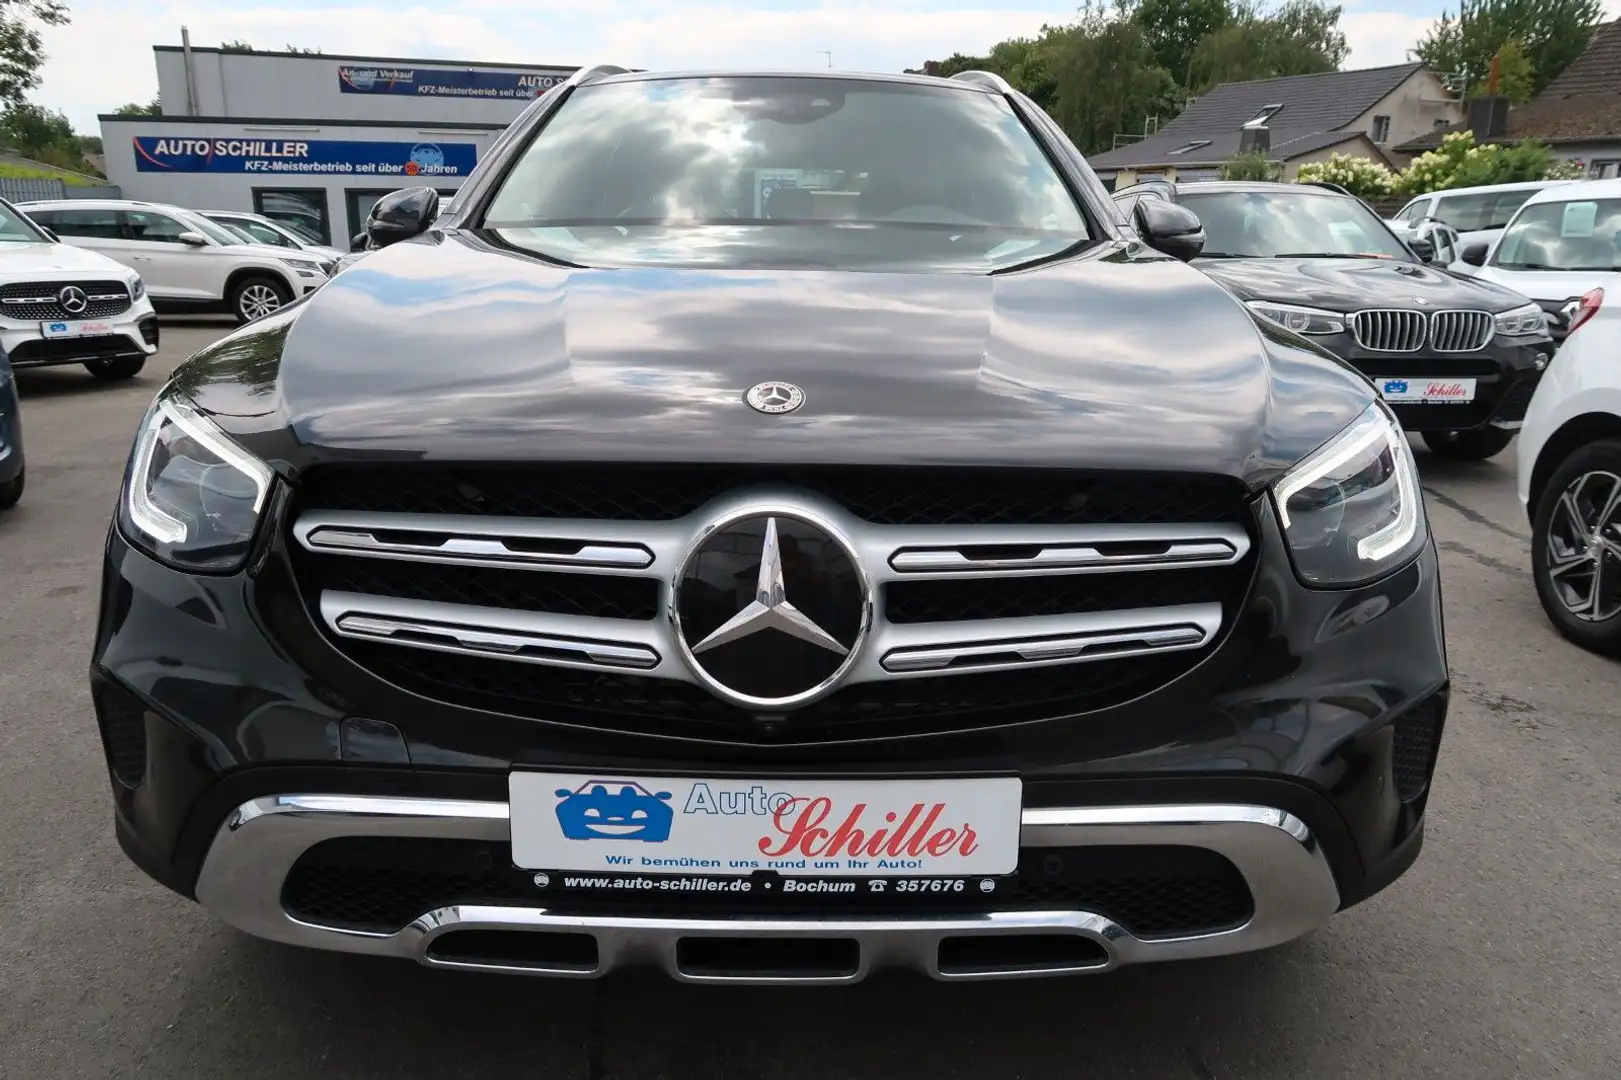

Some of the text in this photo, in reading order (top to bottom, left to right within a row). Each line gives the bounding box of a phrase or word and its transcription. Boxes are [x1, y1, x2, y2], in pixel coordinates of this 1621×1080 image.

[379, 70, 414, 79] Verkauf
[518, 76, 553, 87] AUTO
[418, 85, 498, 96] KFZ-Meisterbetrieb
[499, 88, 514, 97] seit
[515, 89, 533, 97] über
[154, 139, 308, 158] AUTO SCHILLER
[245, 160, 352, 173] KFZ-Meisterbetrieb
[355, 162, 375, 173] seit
[378, 162, 403, 174] über
[421, 165, 458, 174] Jahren
[683, 782, 979, 858] Auto Schiller
[605, 855, 923, 869] Wir bemühen uns rund um Ihr Auto!
[564, 876, 965, 893] www.auto-schiller.de Bochum 357676
